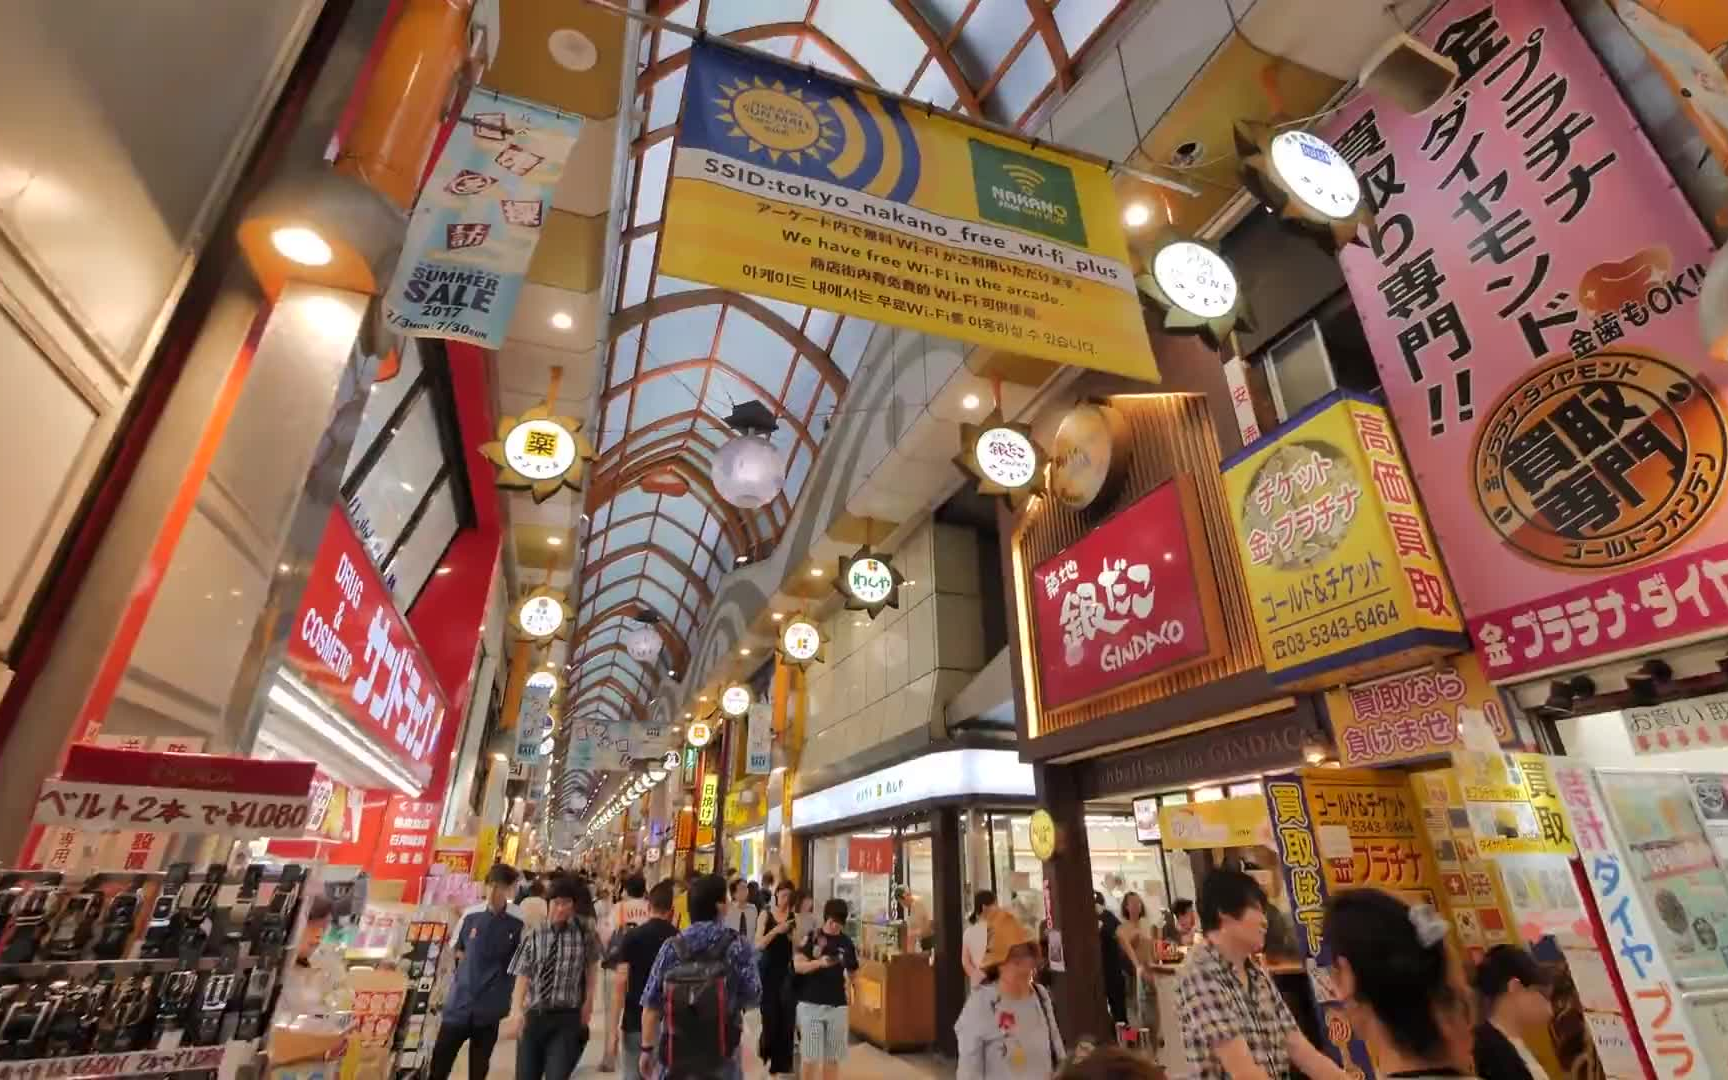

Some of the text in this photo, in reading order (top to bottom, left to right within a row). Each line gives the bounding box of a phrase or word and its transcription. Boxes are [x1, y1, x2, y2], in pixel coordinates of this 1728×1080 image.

[1484, 27, 1616, 222] プラチナ
[756, 202, 892, 245] アーケード内で無料
[897, 236, 939, 258] Wi-Fi
[1420, 90, 1578, 359] ダイヤモンド
[403, 280, 497, 314] SALE
[412, 266, 499, 292] SUMMER
[782, 229, 1065, 306] We have free Wi-Fi in the arcade.
[934, 284, 977, 308] Wi-Fi
[422, 305, 463, 318] 2017
[527, 431, 555, 456] 薬
[1504, 381, 1649, 497] 買取
[1255, 452, 1333, 517] チケット
[1530, 418, 1690, 538] 専門
[1246, 483, 1362, 567] 金・プラチナ
[1353, 412, 1452, 618] 高価買取
[335, 552, 363, 611] DRUG
[1060, 557, 1155, 667] 銀だこ
[301, 607, 353, 683] COSMETIC
[333, 601, 345, 631] &
[1101, 619, 1184, 673] GINDACO
[1350, 670, 1465, 722] 買取なら
[1520, 761, 1570, 845] 買取
